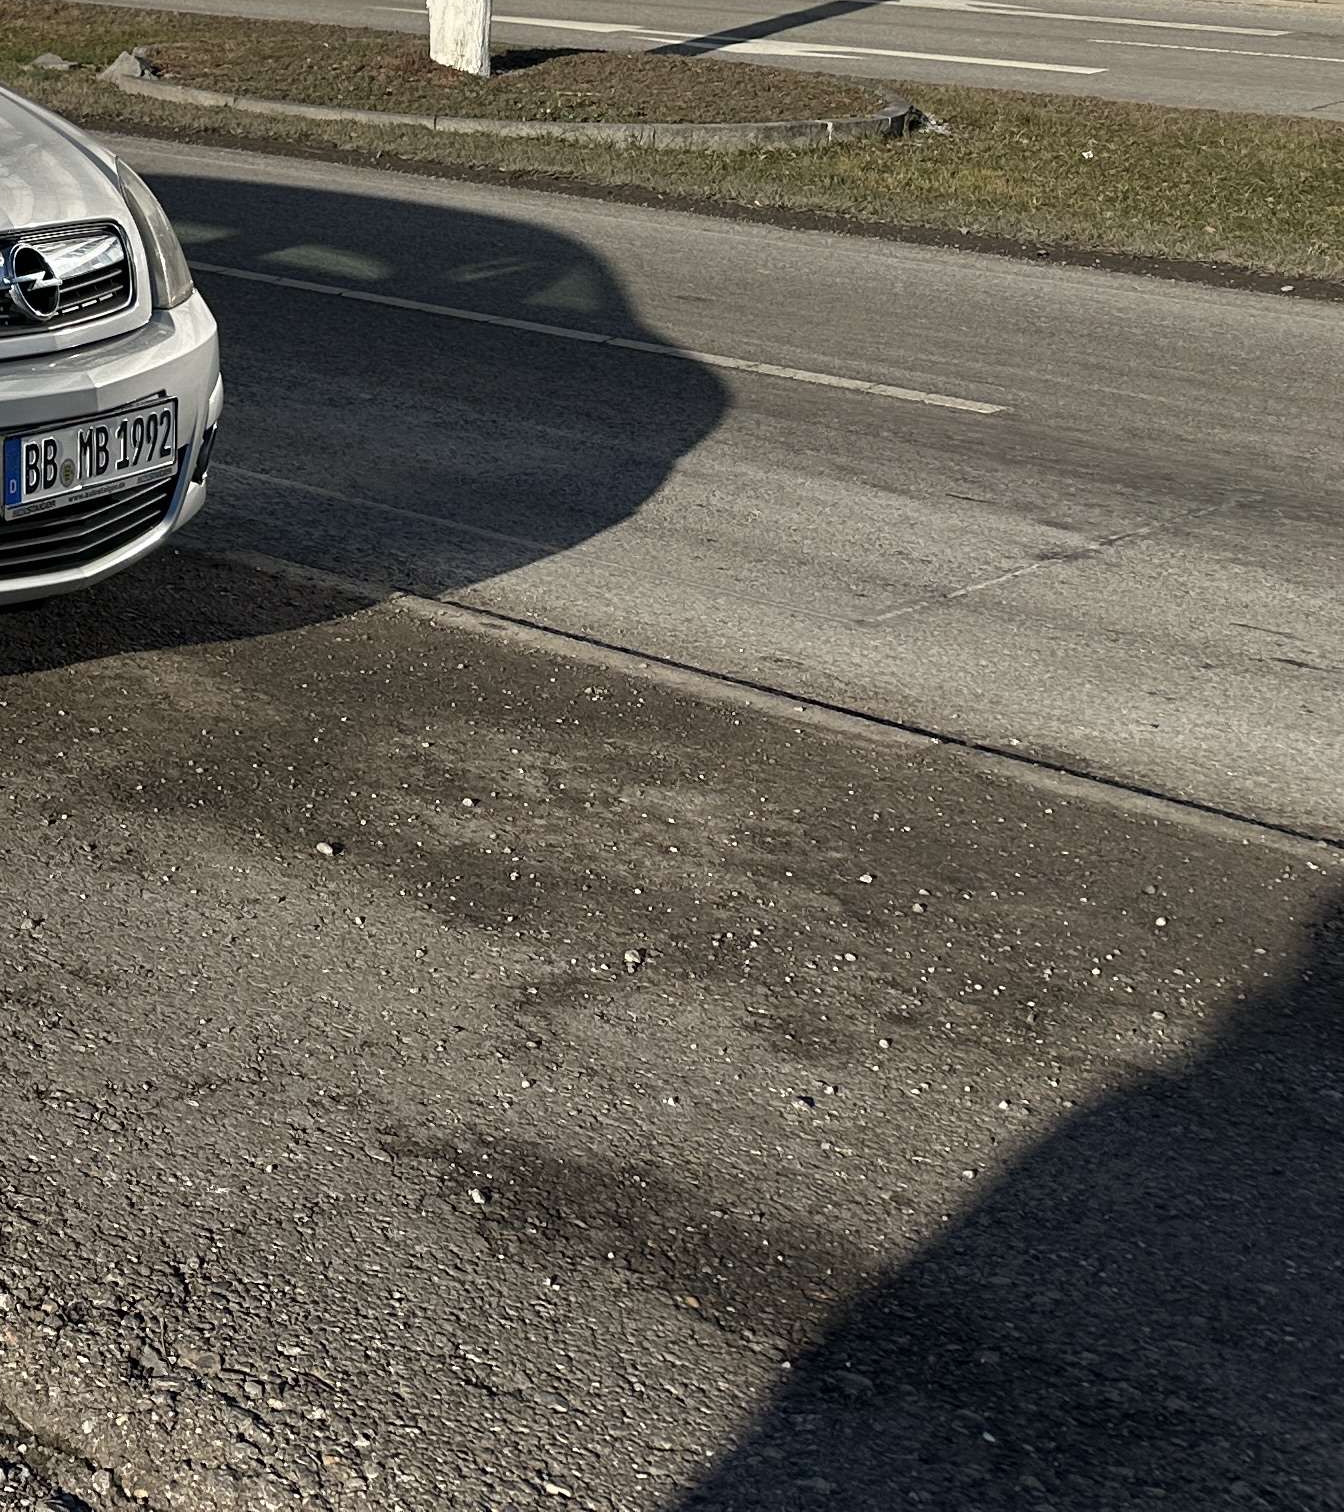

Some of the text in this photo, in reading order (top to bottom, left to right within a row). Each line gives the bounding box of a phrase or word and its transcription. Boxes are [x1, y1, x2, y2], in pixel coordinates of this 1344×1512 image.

[24, 408, 172, 495] BB MB 1992
